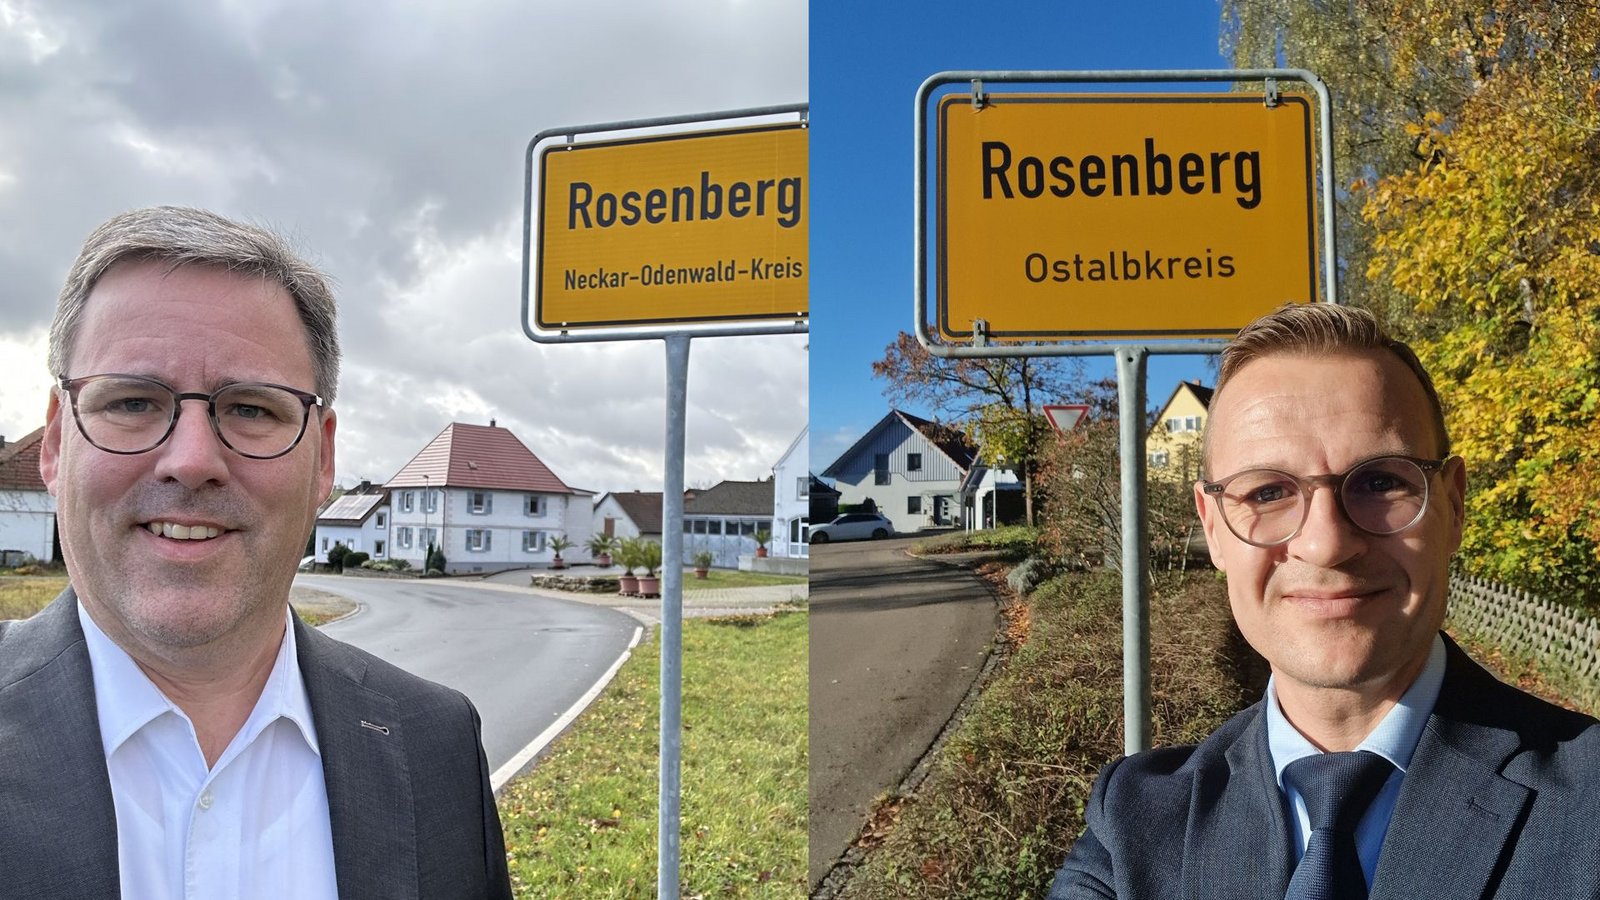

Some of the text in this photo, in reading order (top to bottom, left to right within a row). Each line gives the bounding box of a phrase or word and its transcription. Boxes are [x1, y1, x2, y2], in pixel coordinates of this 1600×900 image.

[981, 137, 1262, 210] Rosenberg
[568, 171, 802, 229] Rosenberg
[564, 256, 803, 291] Neckar-Odenwald-Kreis
[1024, 248, 1236, 283] Ostalbkreis
